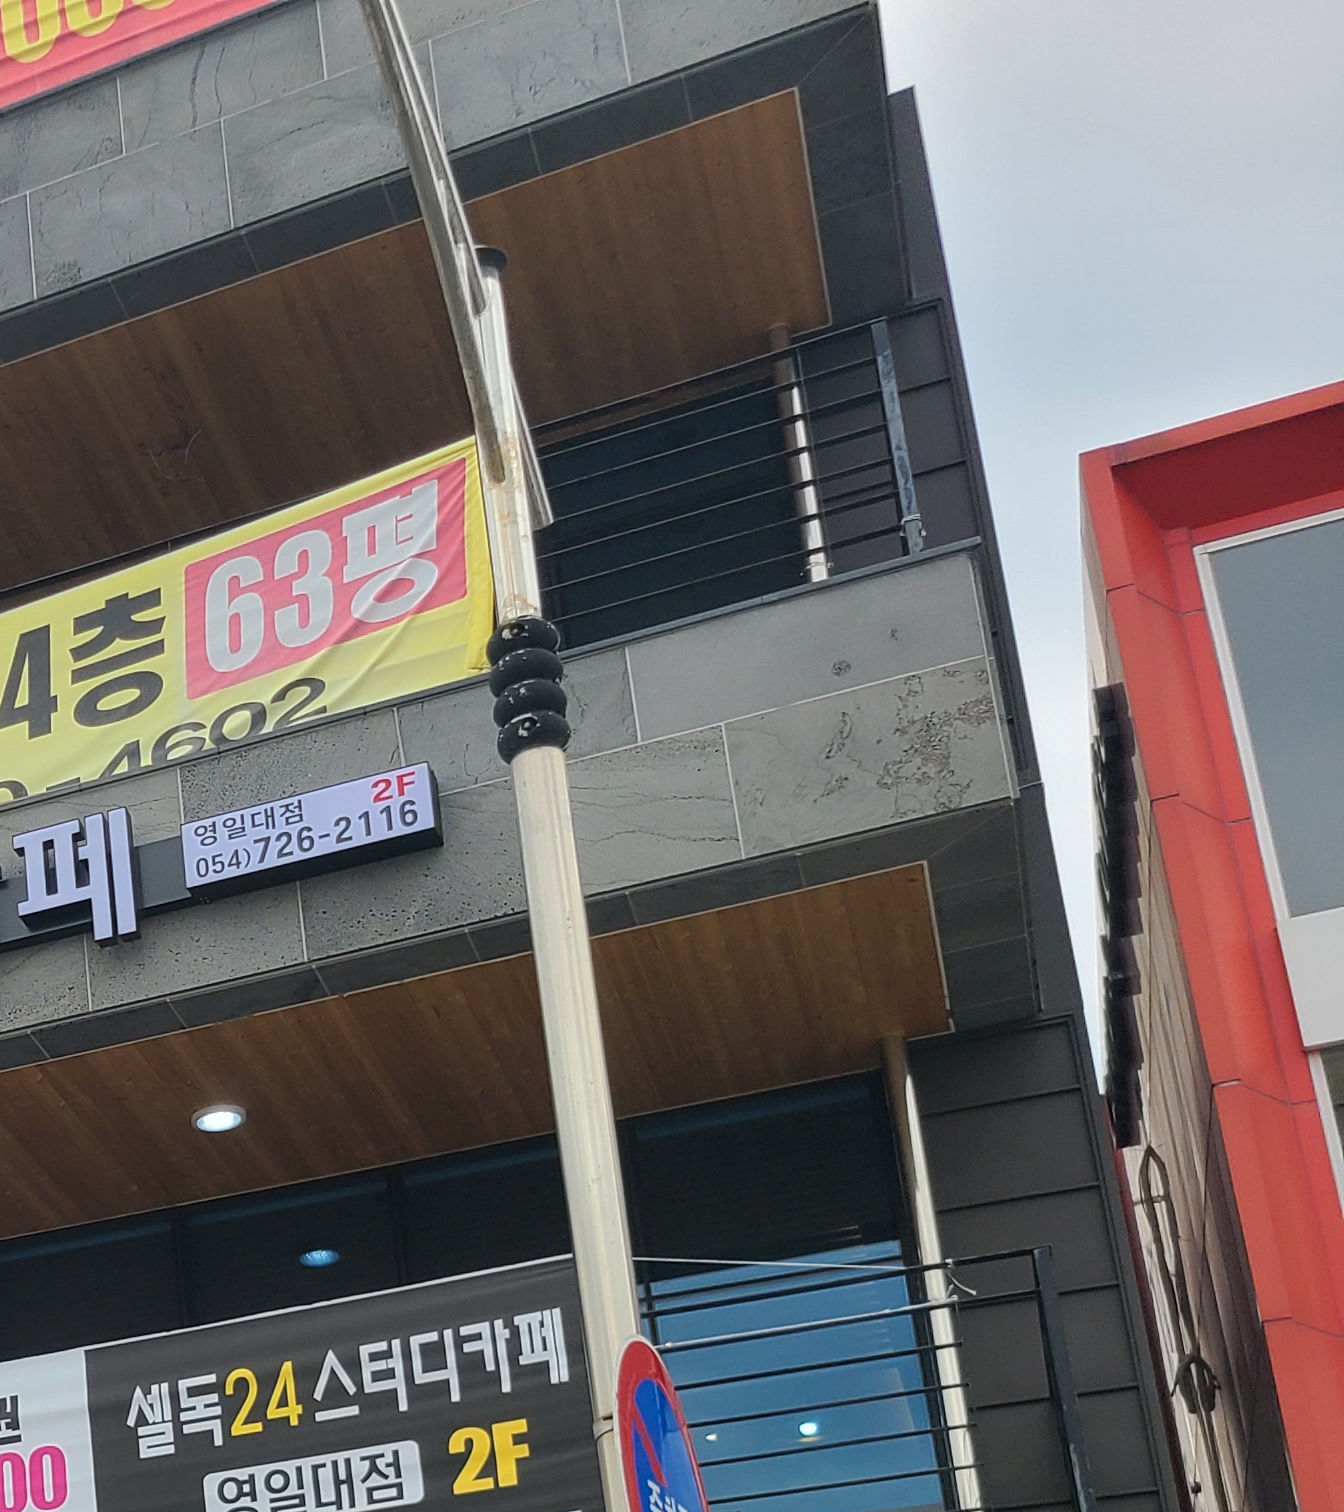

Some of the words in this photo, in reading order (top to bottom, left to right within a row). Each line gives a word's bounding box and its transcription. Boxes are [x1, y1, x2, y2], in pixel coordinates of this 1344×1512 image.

[204, 479, 439, 674] 63평
[194, 800, 305, 847] 영일대점
[371, 771, 416, 803] 2F
[196, 800, 418, 878] 054)726-2116
[448, 1420, 530, 1495] 2F
